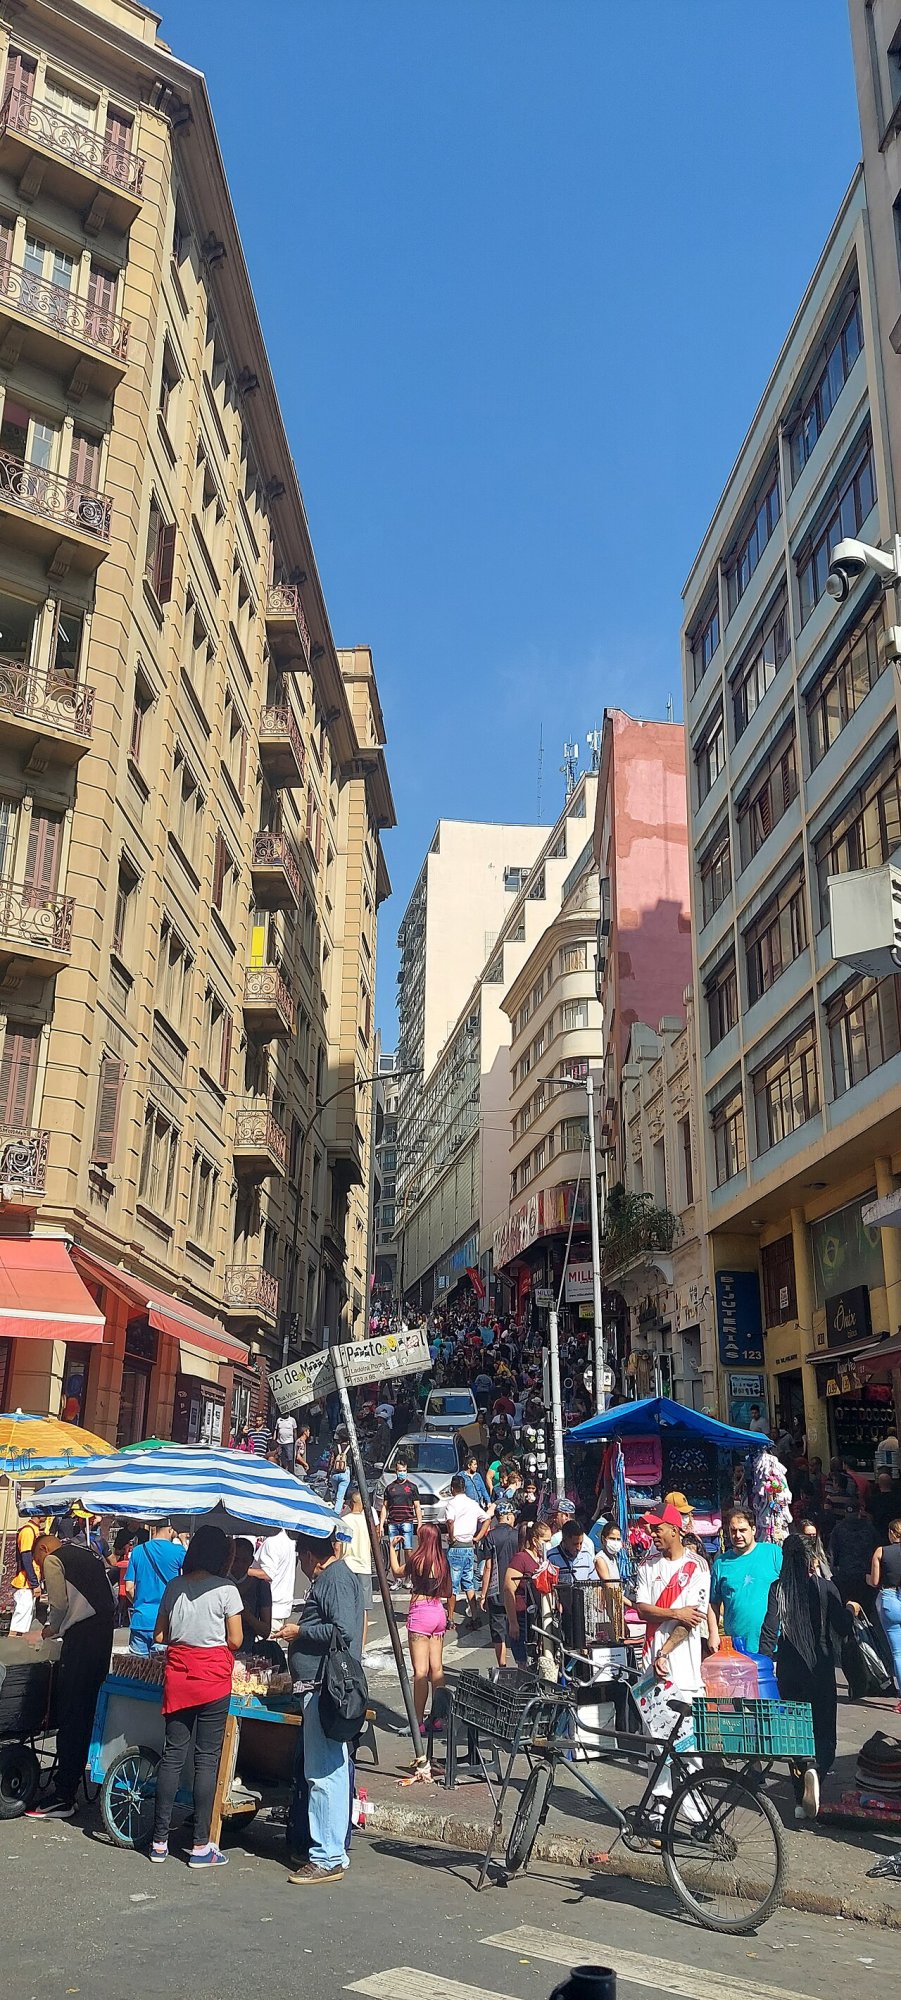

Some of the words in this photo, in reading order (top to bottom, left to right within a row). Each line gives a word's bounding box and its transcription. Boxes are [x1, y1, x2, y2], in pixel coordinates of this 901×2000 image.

[721, 1276, 739, 1359] BIJUTERIAS
[834, 1300, 856, 1331] Ônix
[742, 1350, 762, 1360] 123
[269, 1374, 283, 1391] 25
[284, 1368, 298, 1385] de
